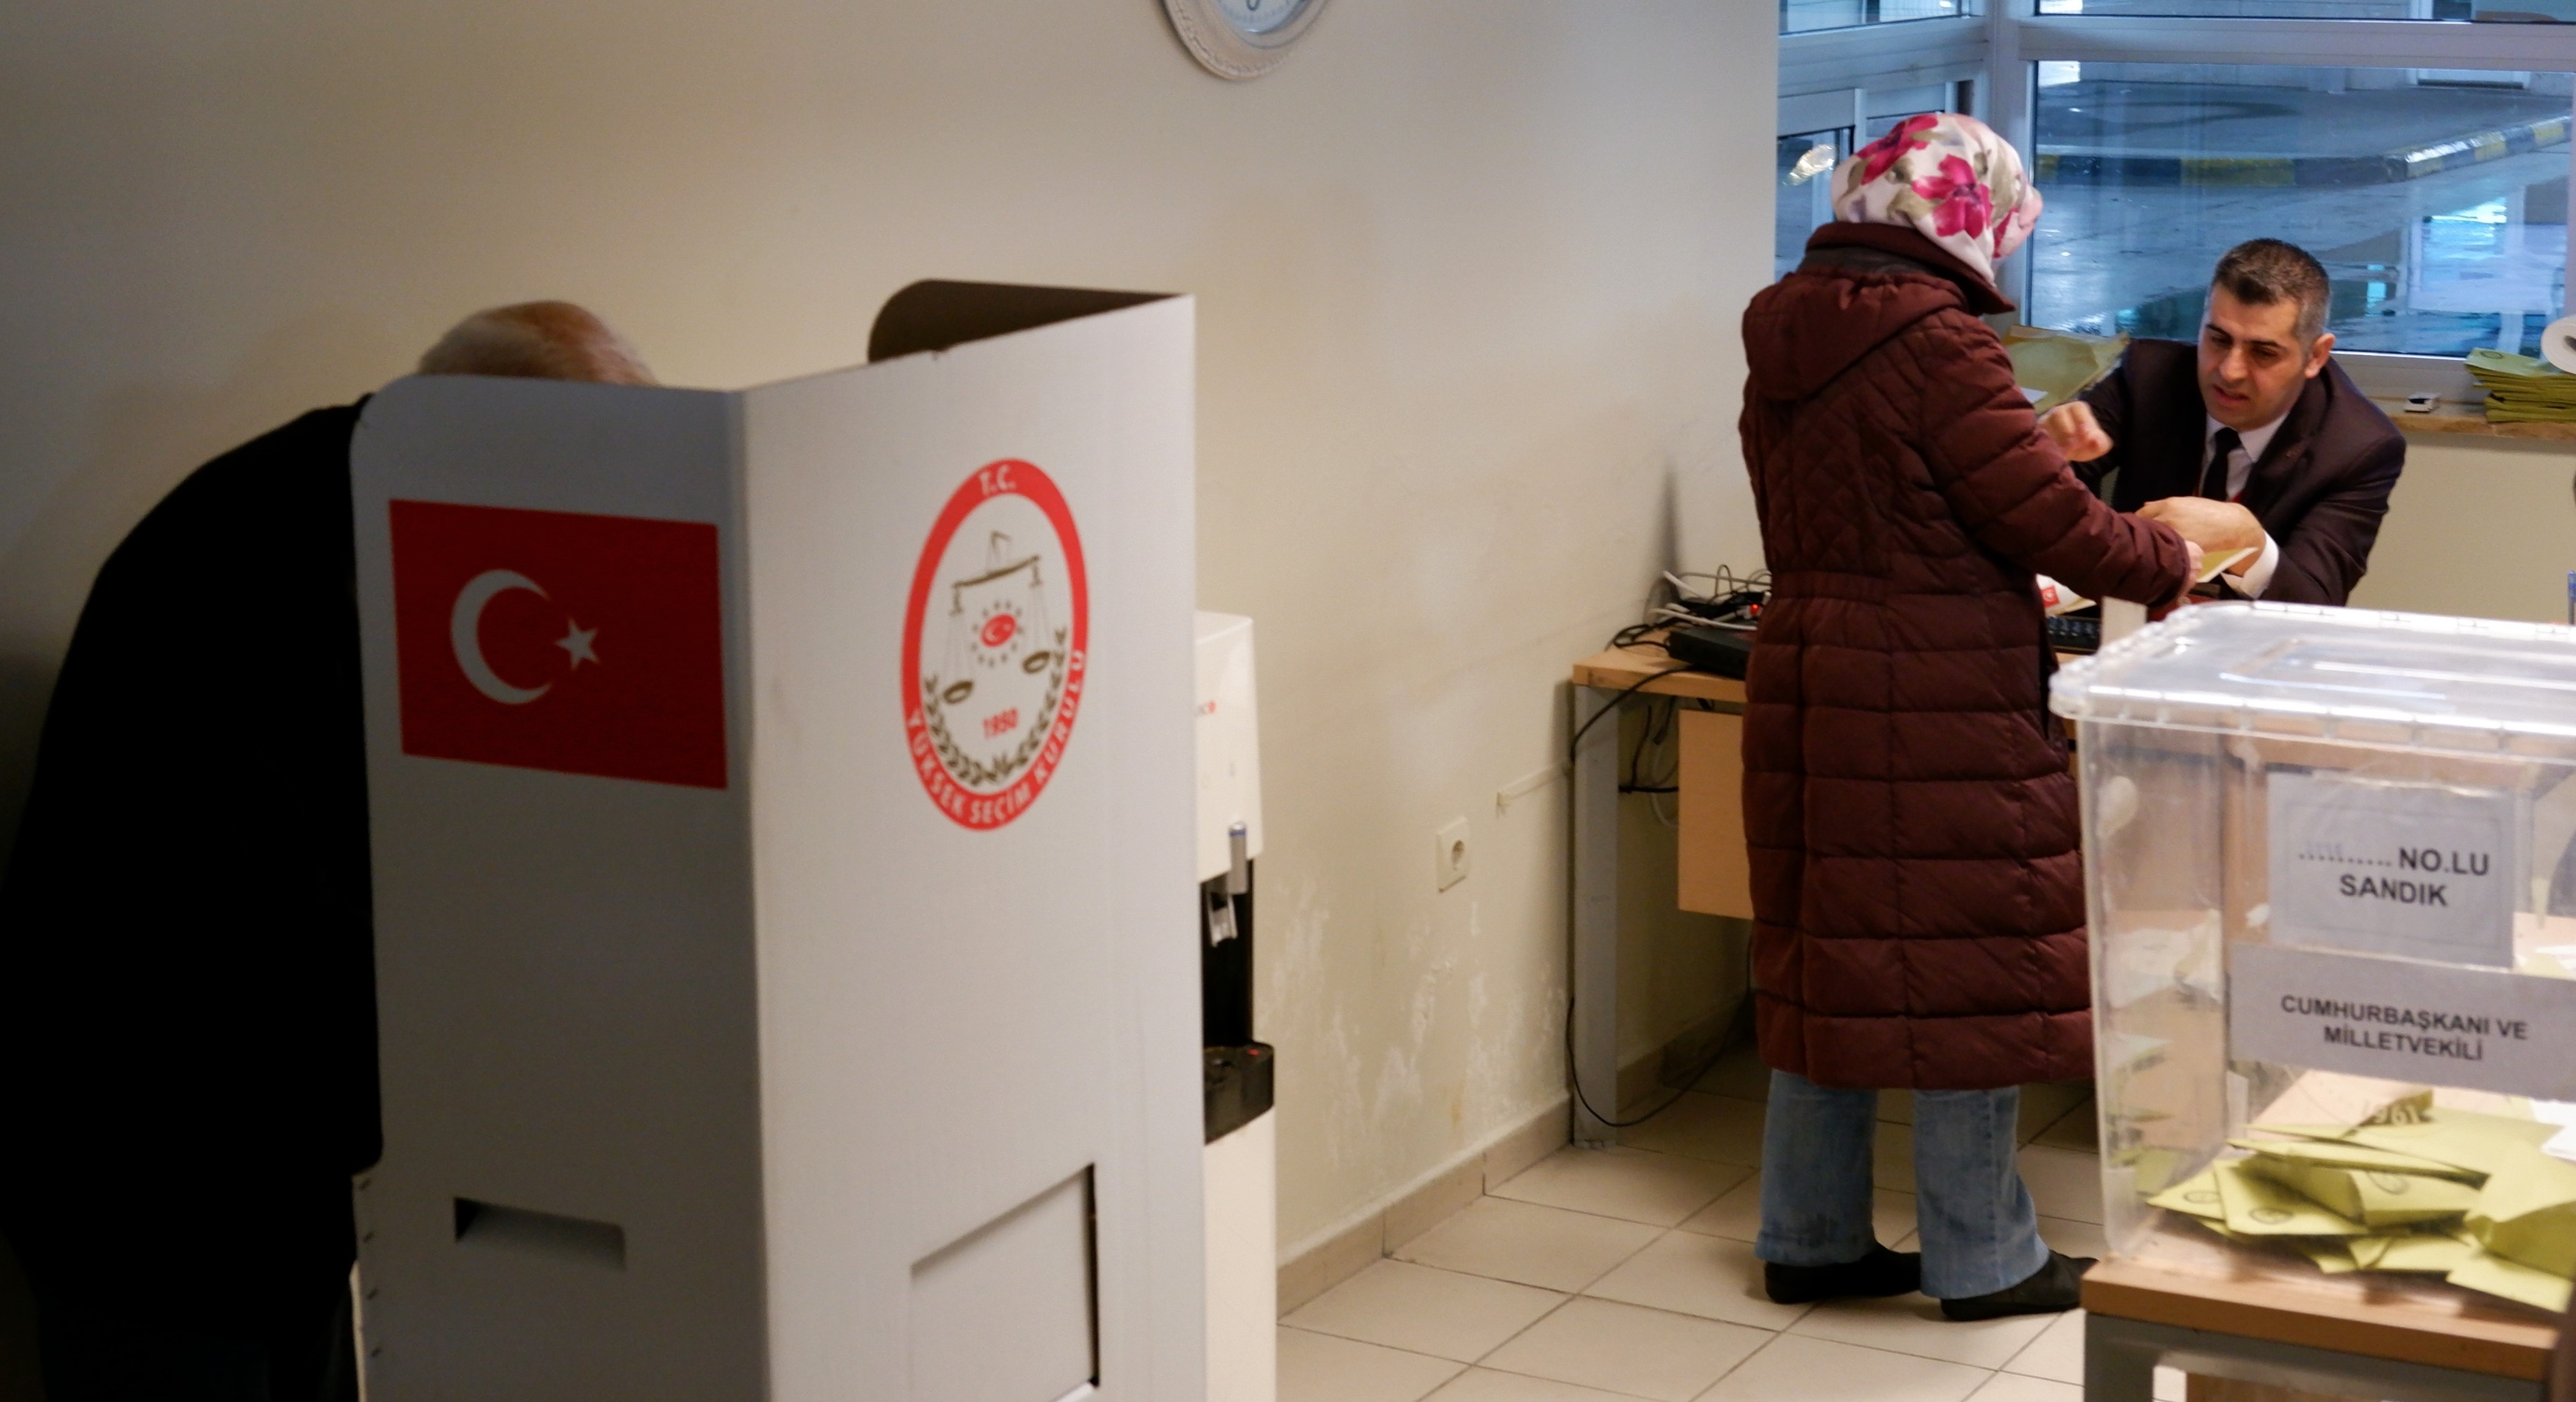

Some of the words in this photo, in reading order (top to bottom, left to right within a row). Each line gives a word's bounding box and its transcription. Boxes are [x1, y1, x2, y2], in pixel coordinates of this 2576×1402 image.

[980, 464, 1016, 496] T.C.
[908, 708, 965, 818] YÜKSEK
[1034, 650, 1085, 785] KURULU
[2399, 845, 2490, 876] NO.LU
[2339, 873, 2448, 906] SANDIK
[2280, 994, 2489, 1035] CUMHURBAŞKANI
[2496, 1018, 2529, 1040] VE
[2322, 1023, 2483, 1061] MİLLETVEKİLİ
